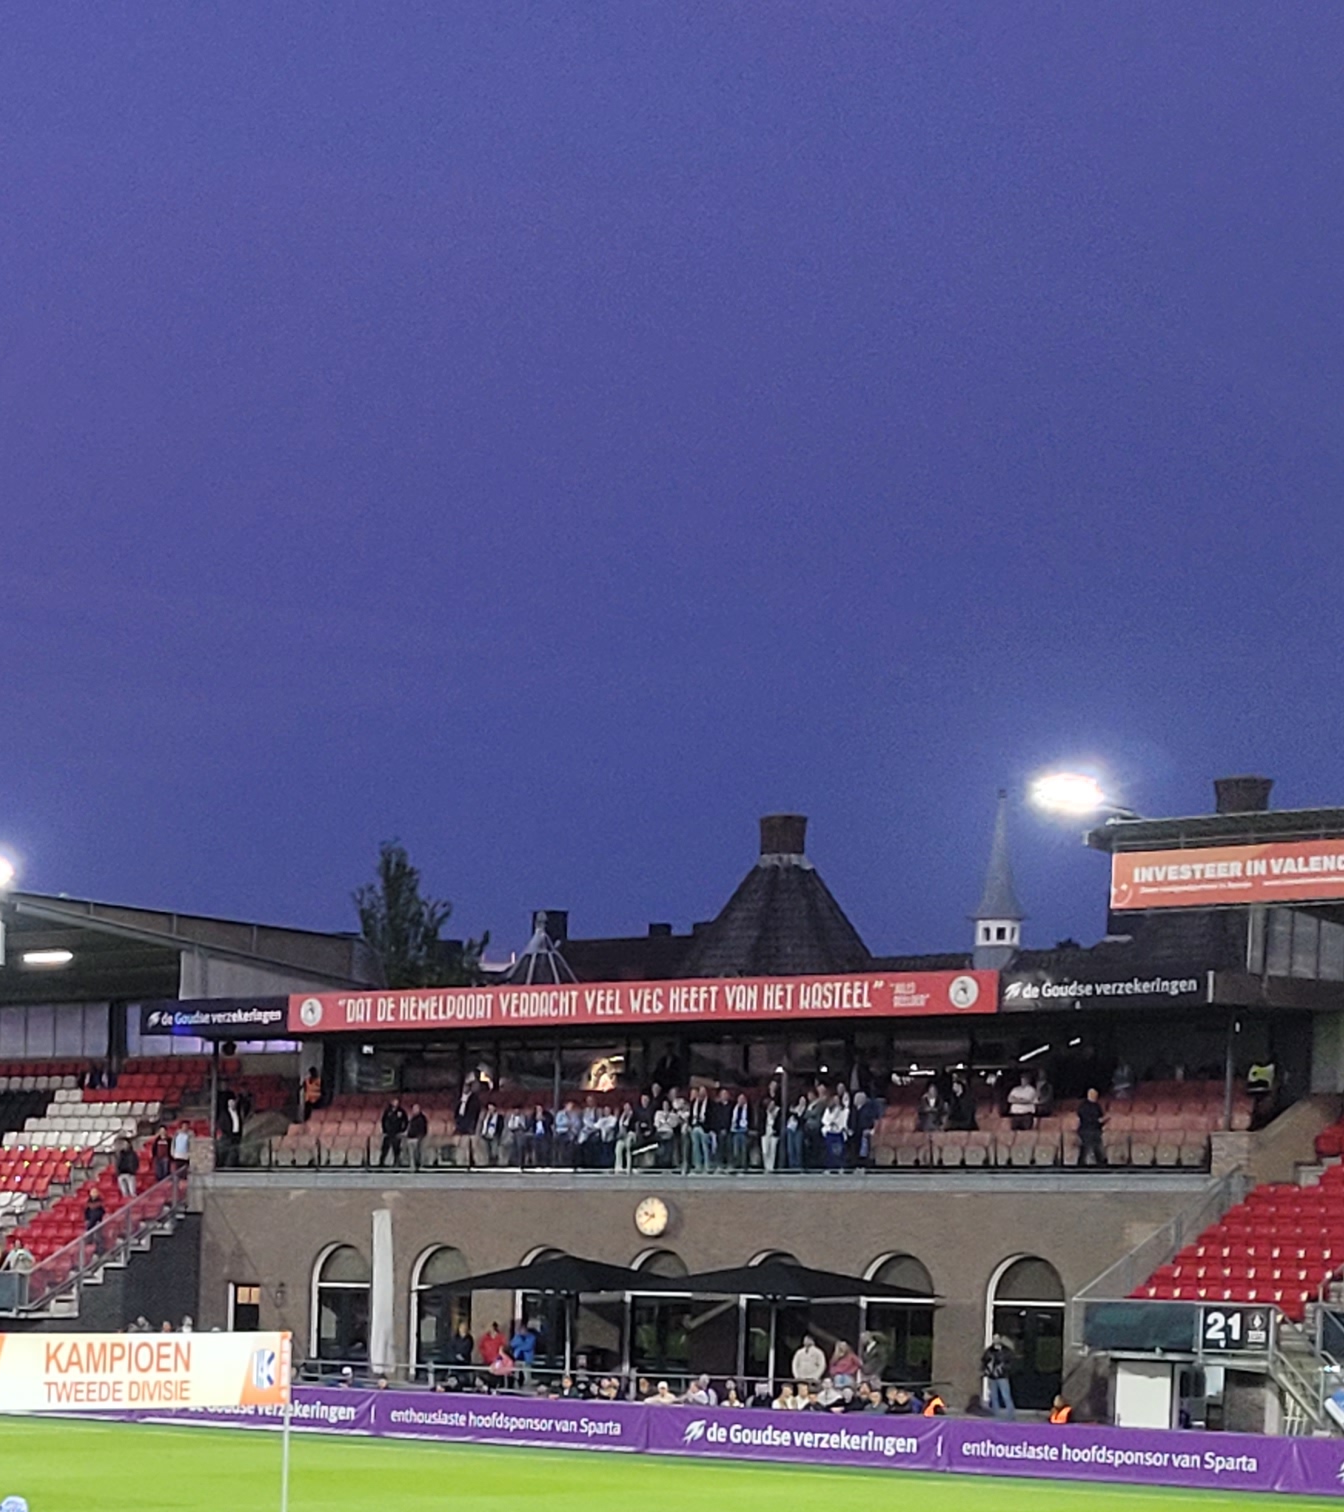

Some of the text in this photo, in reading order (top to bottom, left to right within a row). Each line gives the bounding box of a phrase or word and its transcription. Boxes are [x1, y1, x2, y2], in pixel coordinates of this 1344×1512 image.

[1133, 862, 1242, 883] INVESTEER
[1246, 859, 1266, 876] IN
[377, 997, 395, 1022] DE
[399, 993, 494, 1022] HEMELPOORT
[499, 990, 579, 1018] VERDACHT
[584, 988, 624, 1016] VEEL
[629, 987, 665, 1015] WEG
[669, 985, 719, 1014] HEEFT
[724, 984, 758, 1012] VAN
[763, 982, 795, 1011] HET
[1022, 977, 1198, 998] de Goudse verzekeringen
[162, 1012, 173, 1026] de
[1206, 1312, 1241, 1341] 21
[45, 1341, 191, 1374] KAMPIOEN
[44, 1379, 191, 1403] TWEEDE DIVISIE
[390, 1407, 621, 1438] enthousiaste hoofdsponsor van Sparta
[706, 1422, 918, 1457] de Goudse verzekeringen
[962, 1438, 1258, 1475] enthousiaste hoofdsponsor van Sparta
